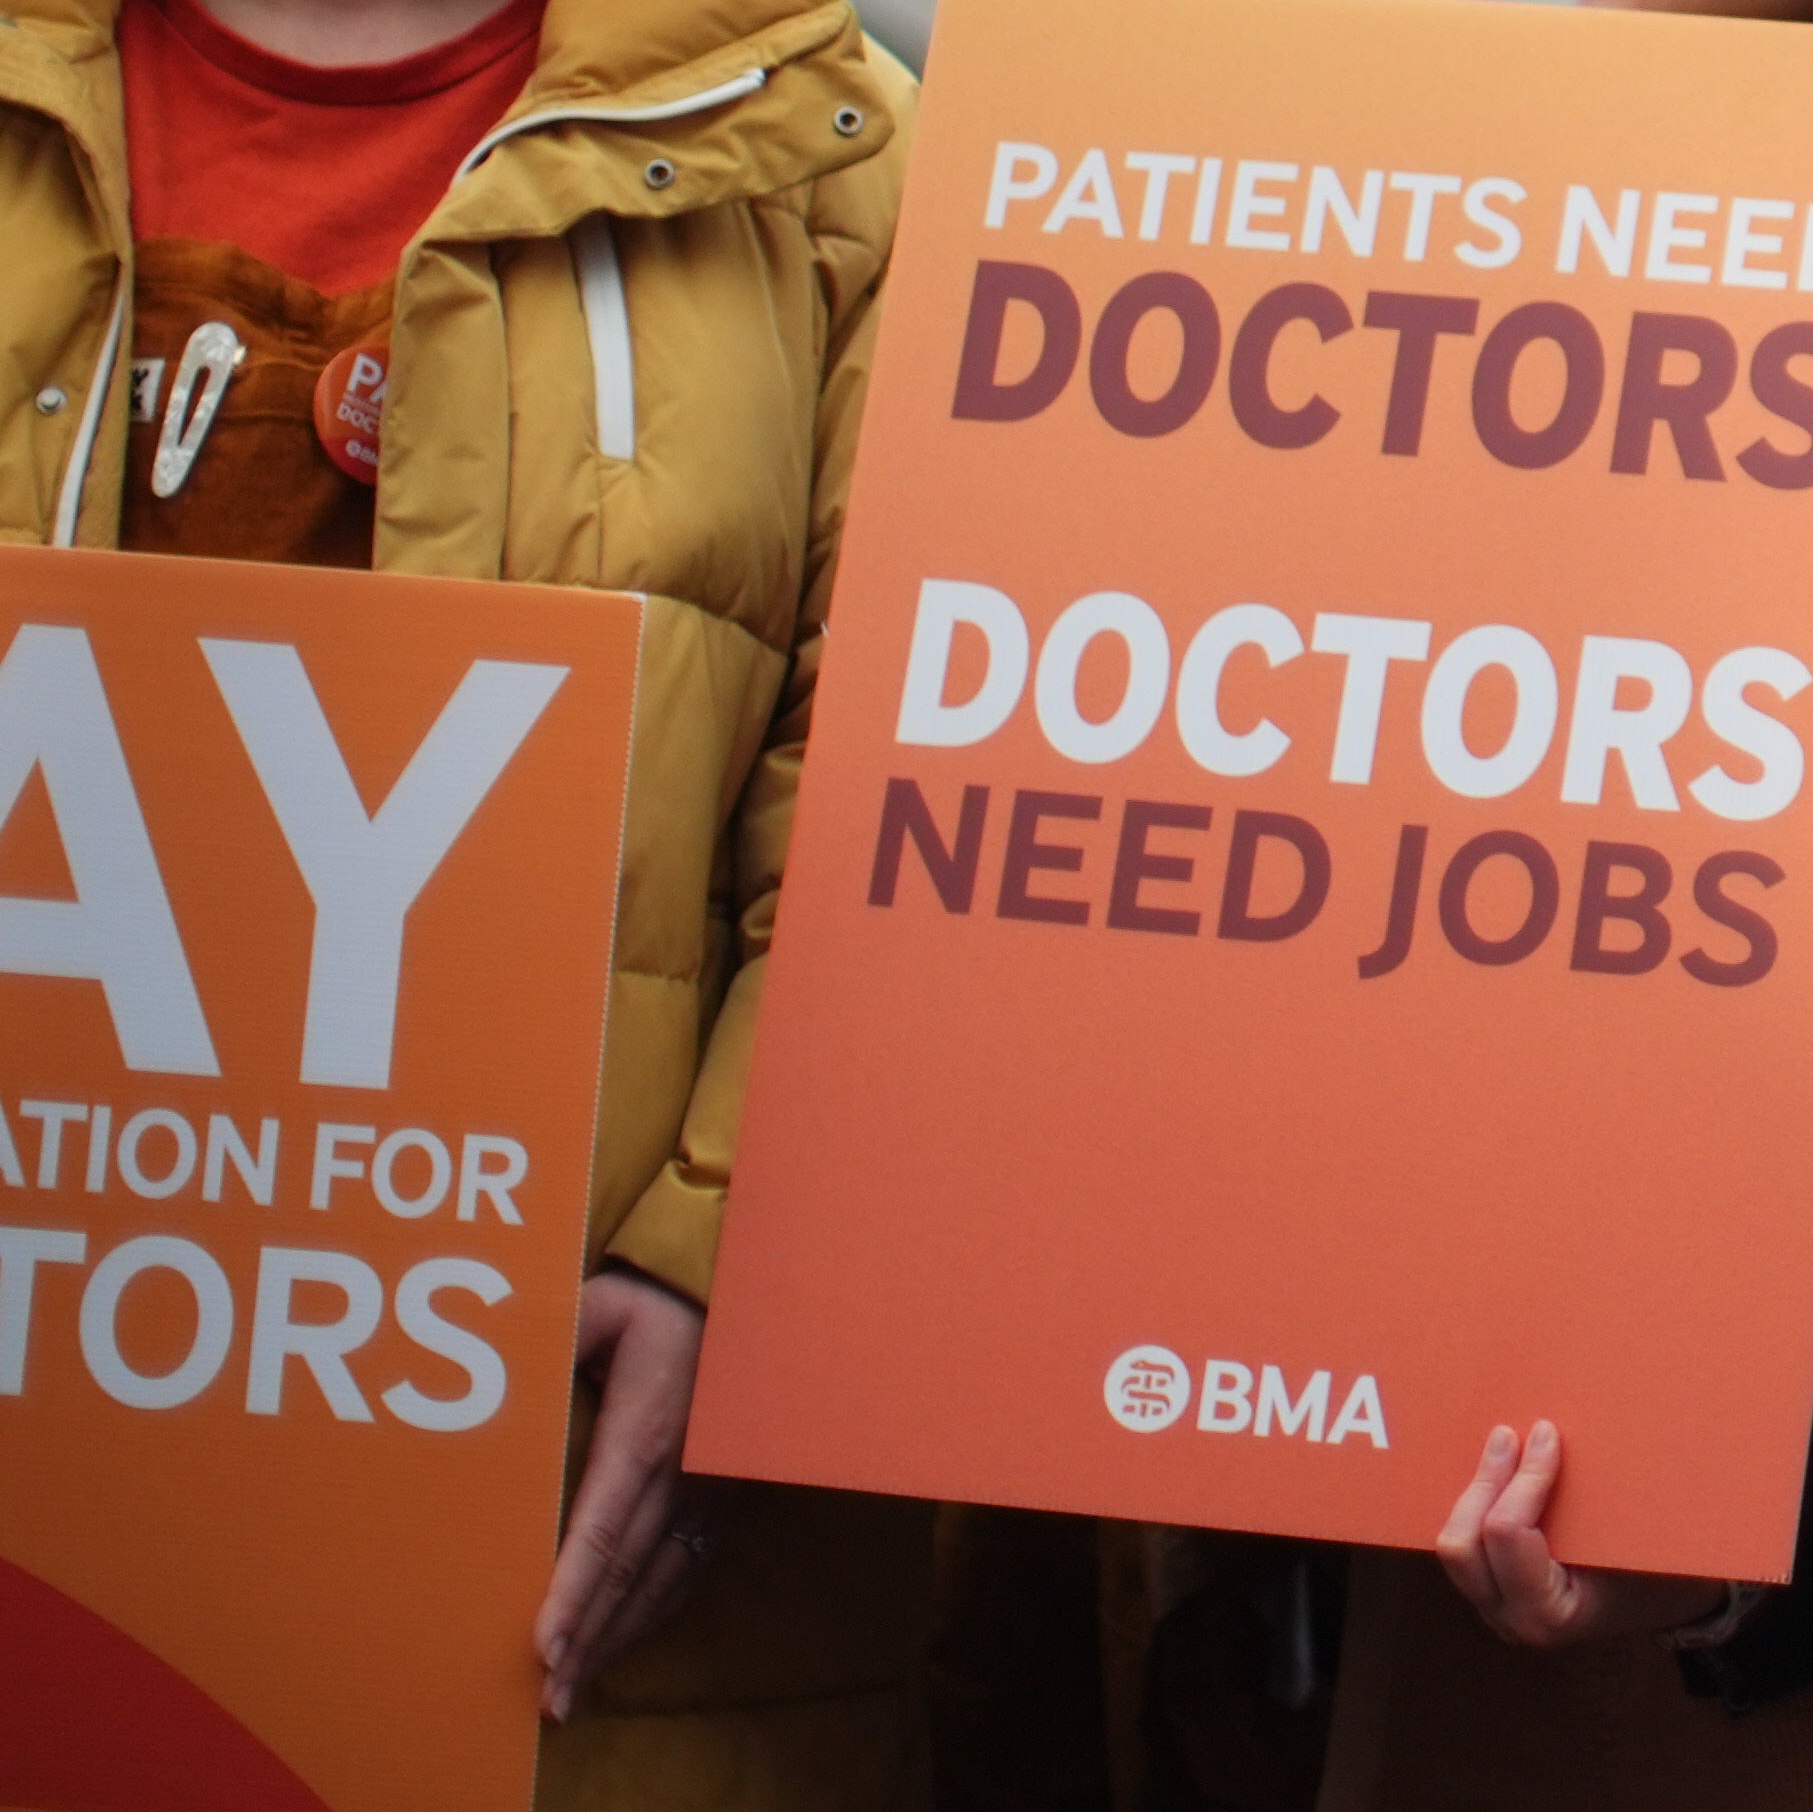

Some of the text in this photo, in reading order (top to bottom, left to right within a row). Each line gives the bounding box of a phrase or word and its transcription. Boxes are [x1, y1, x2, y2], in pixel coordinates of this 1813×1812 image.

[983, 139, 1527, 269] PATIENTS
[895, 578, 1813, 822] DOCTORS
[866, 776, 1788, 988] NEED JOBS
[309, 1122, 529, 1227] FOR
[1196, 1359, 1390, 1450] BMA
